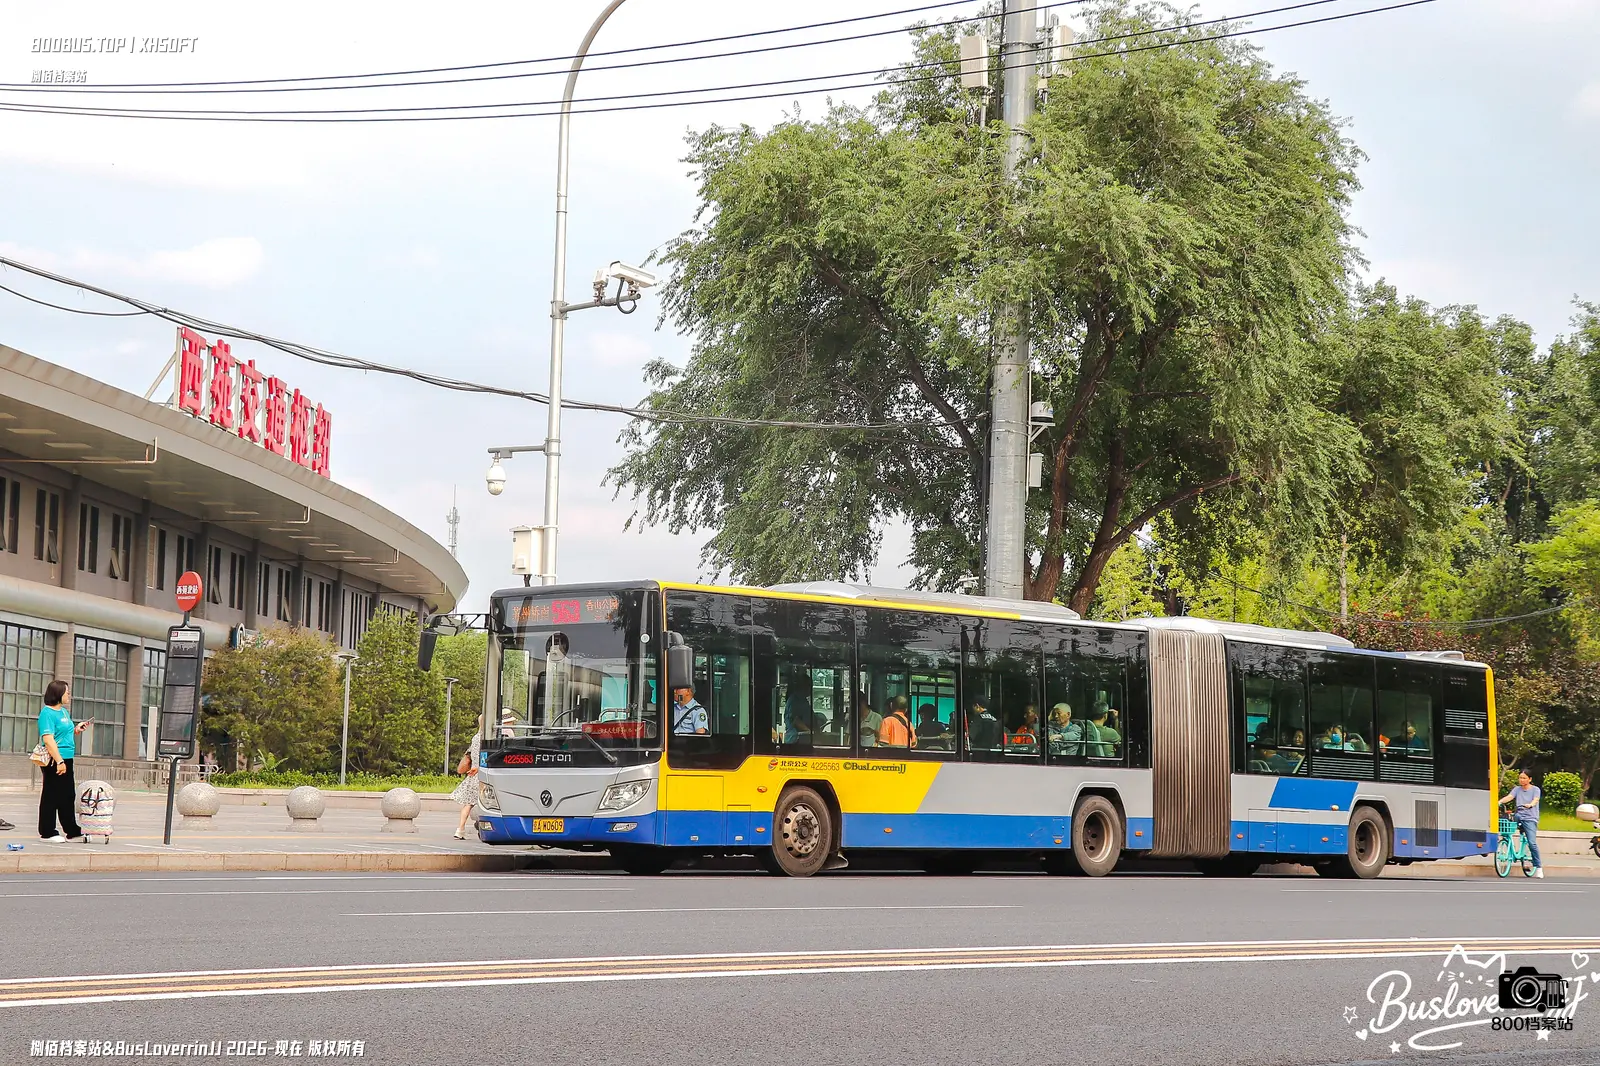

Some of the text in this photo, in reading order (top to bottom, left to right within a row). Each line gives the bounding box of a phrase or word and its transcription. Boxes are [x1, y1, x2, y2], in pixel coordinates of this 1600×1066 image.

[179, 326, 332, 479] 西苑交通枢纽
[503, 753, 572, 764] 4225563 FOTON
[780, 760, 808, 768] 北京公交
[811, 761, 840, 771] 4225563
